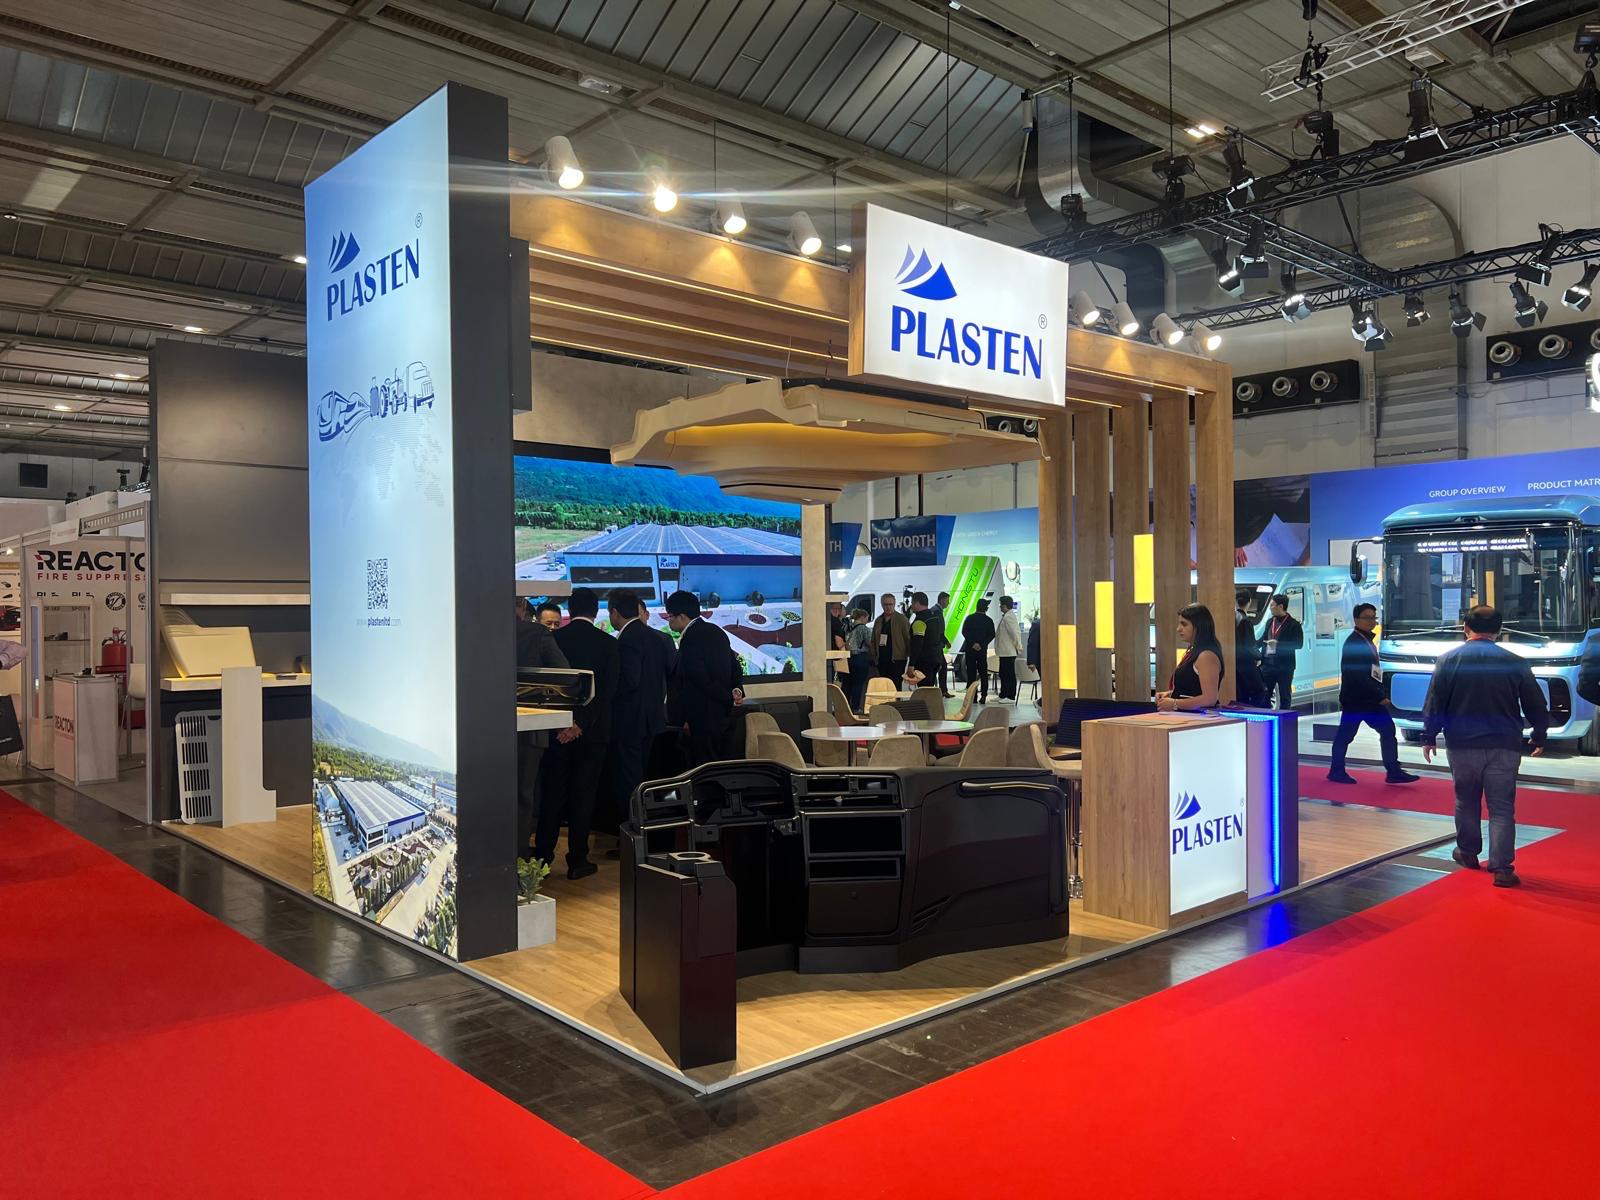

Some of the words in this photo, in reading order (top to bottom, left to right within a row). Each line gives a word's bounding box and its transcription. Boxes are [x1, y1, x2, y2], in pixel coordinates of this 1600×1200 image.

[327, 238, 420, 321] PLASTEN
[891, 304, 1042, 379] PLASTEN
[1429, 488, 1458, 498] GROUP
[1460, 485, 1506, 496] OVERVIEW
[1527, 479, 1572, 490] PRODUCT
[871, 534, 936, 550] SKYWORTH
[37, 573, 68, 581] FIRE
[77, 573, 146, 581] SUPPRS
[955, 568, 979, 620] HONGTU
[1172, 812, 1243, 855] PLASTEN
